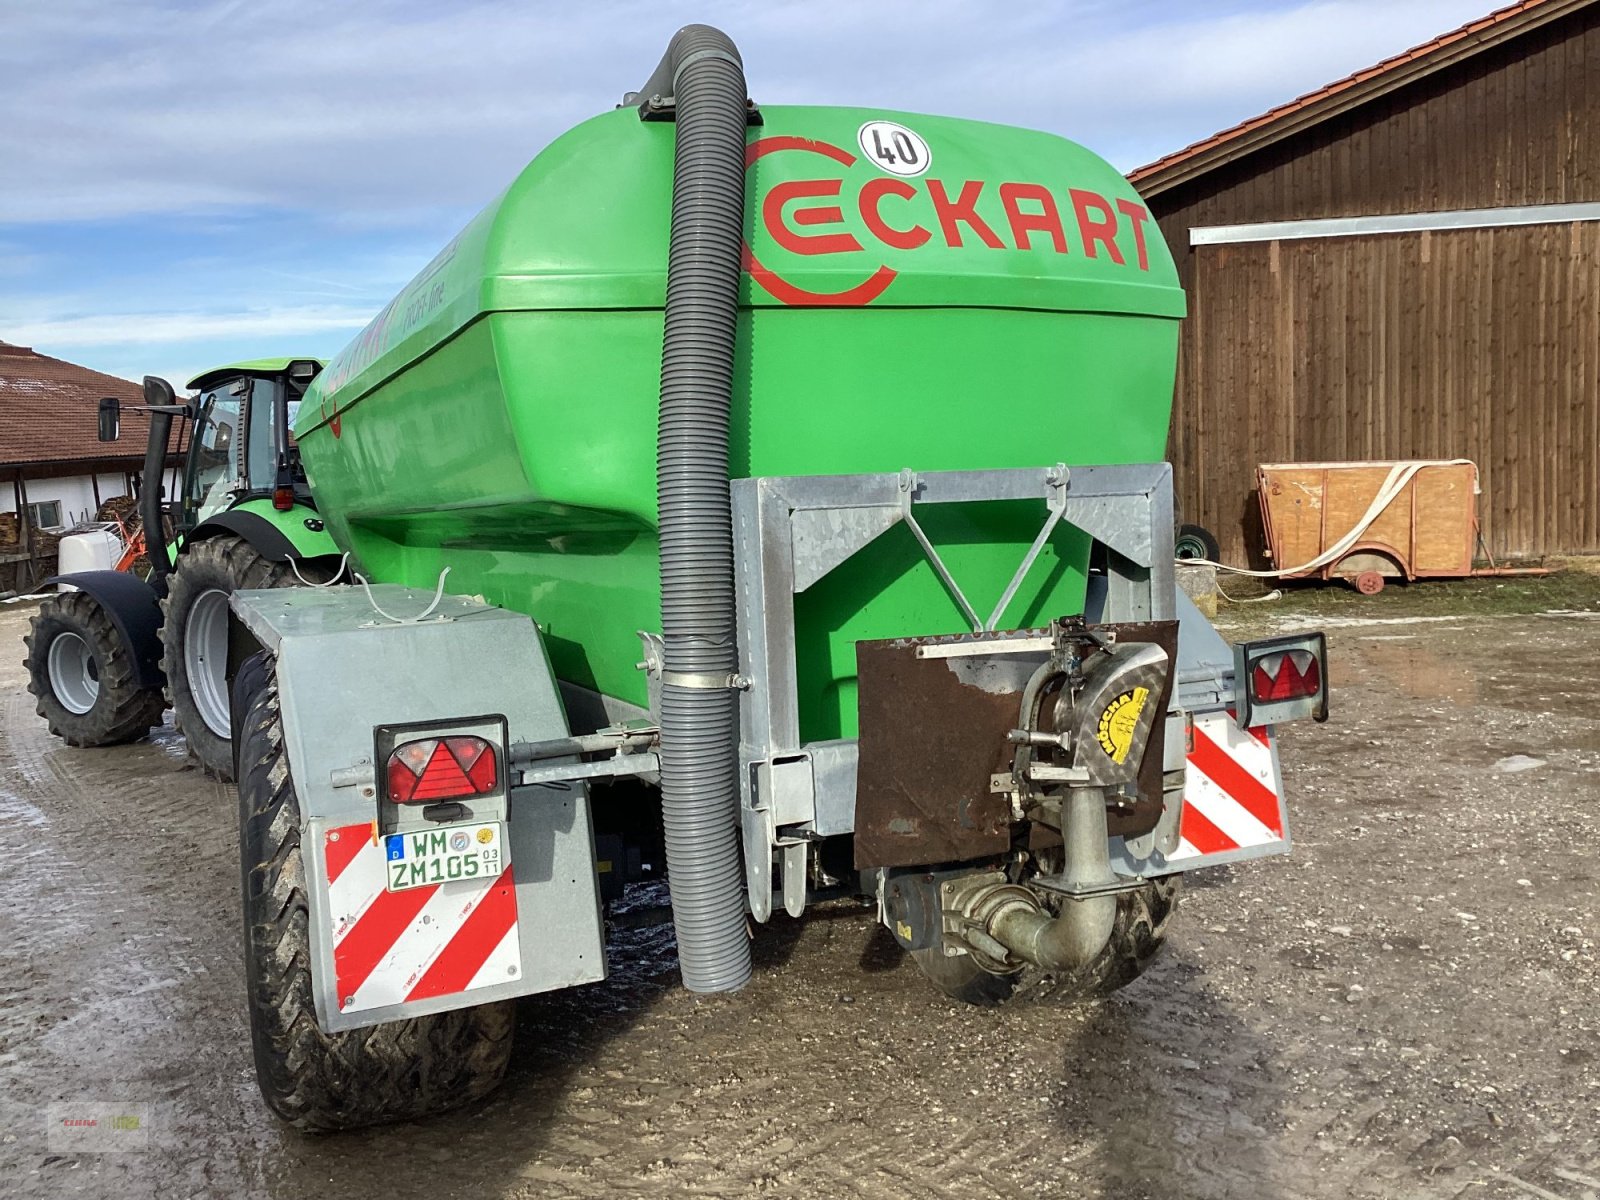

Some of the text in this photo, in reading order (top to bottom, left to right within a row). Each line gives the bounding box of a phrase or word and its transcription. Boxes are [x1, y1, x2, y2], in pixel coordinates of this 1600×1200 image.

[872, 129, 918, 165] 40
[763, 178, 1149, 272] ECKART
[412, 831, 447, 857] WM
[392, 851, 399, 859] D
[483, 849, 498, 859] 03
[485, 864, 497, 874] 11
